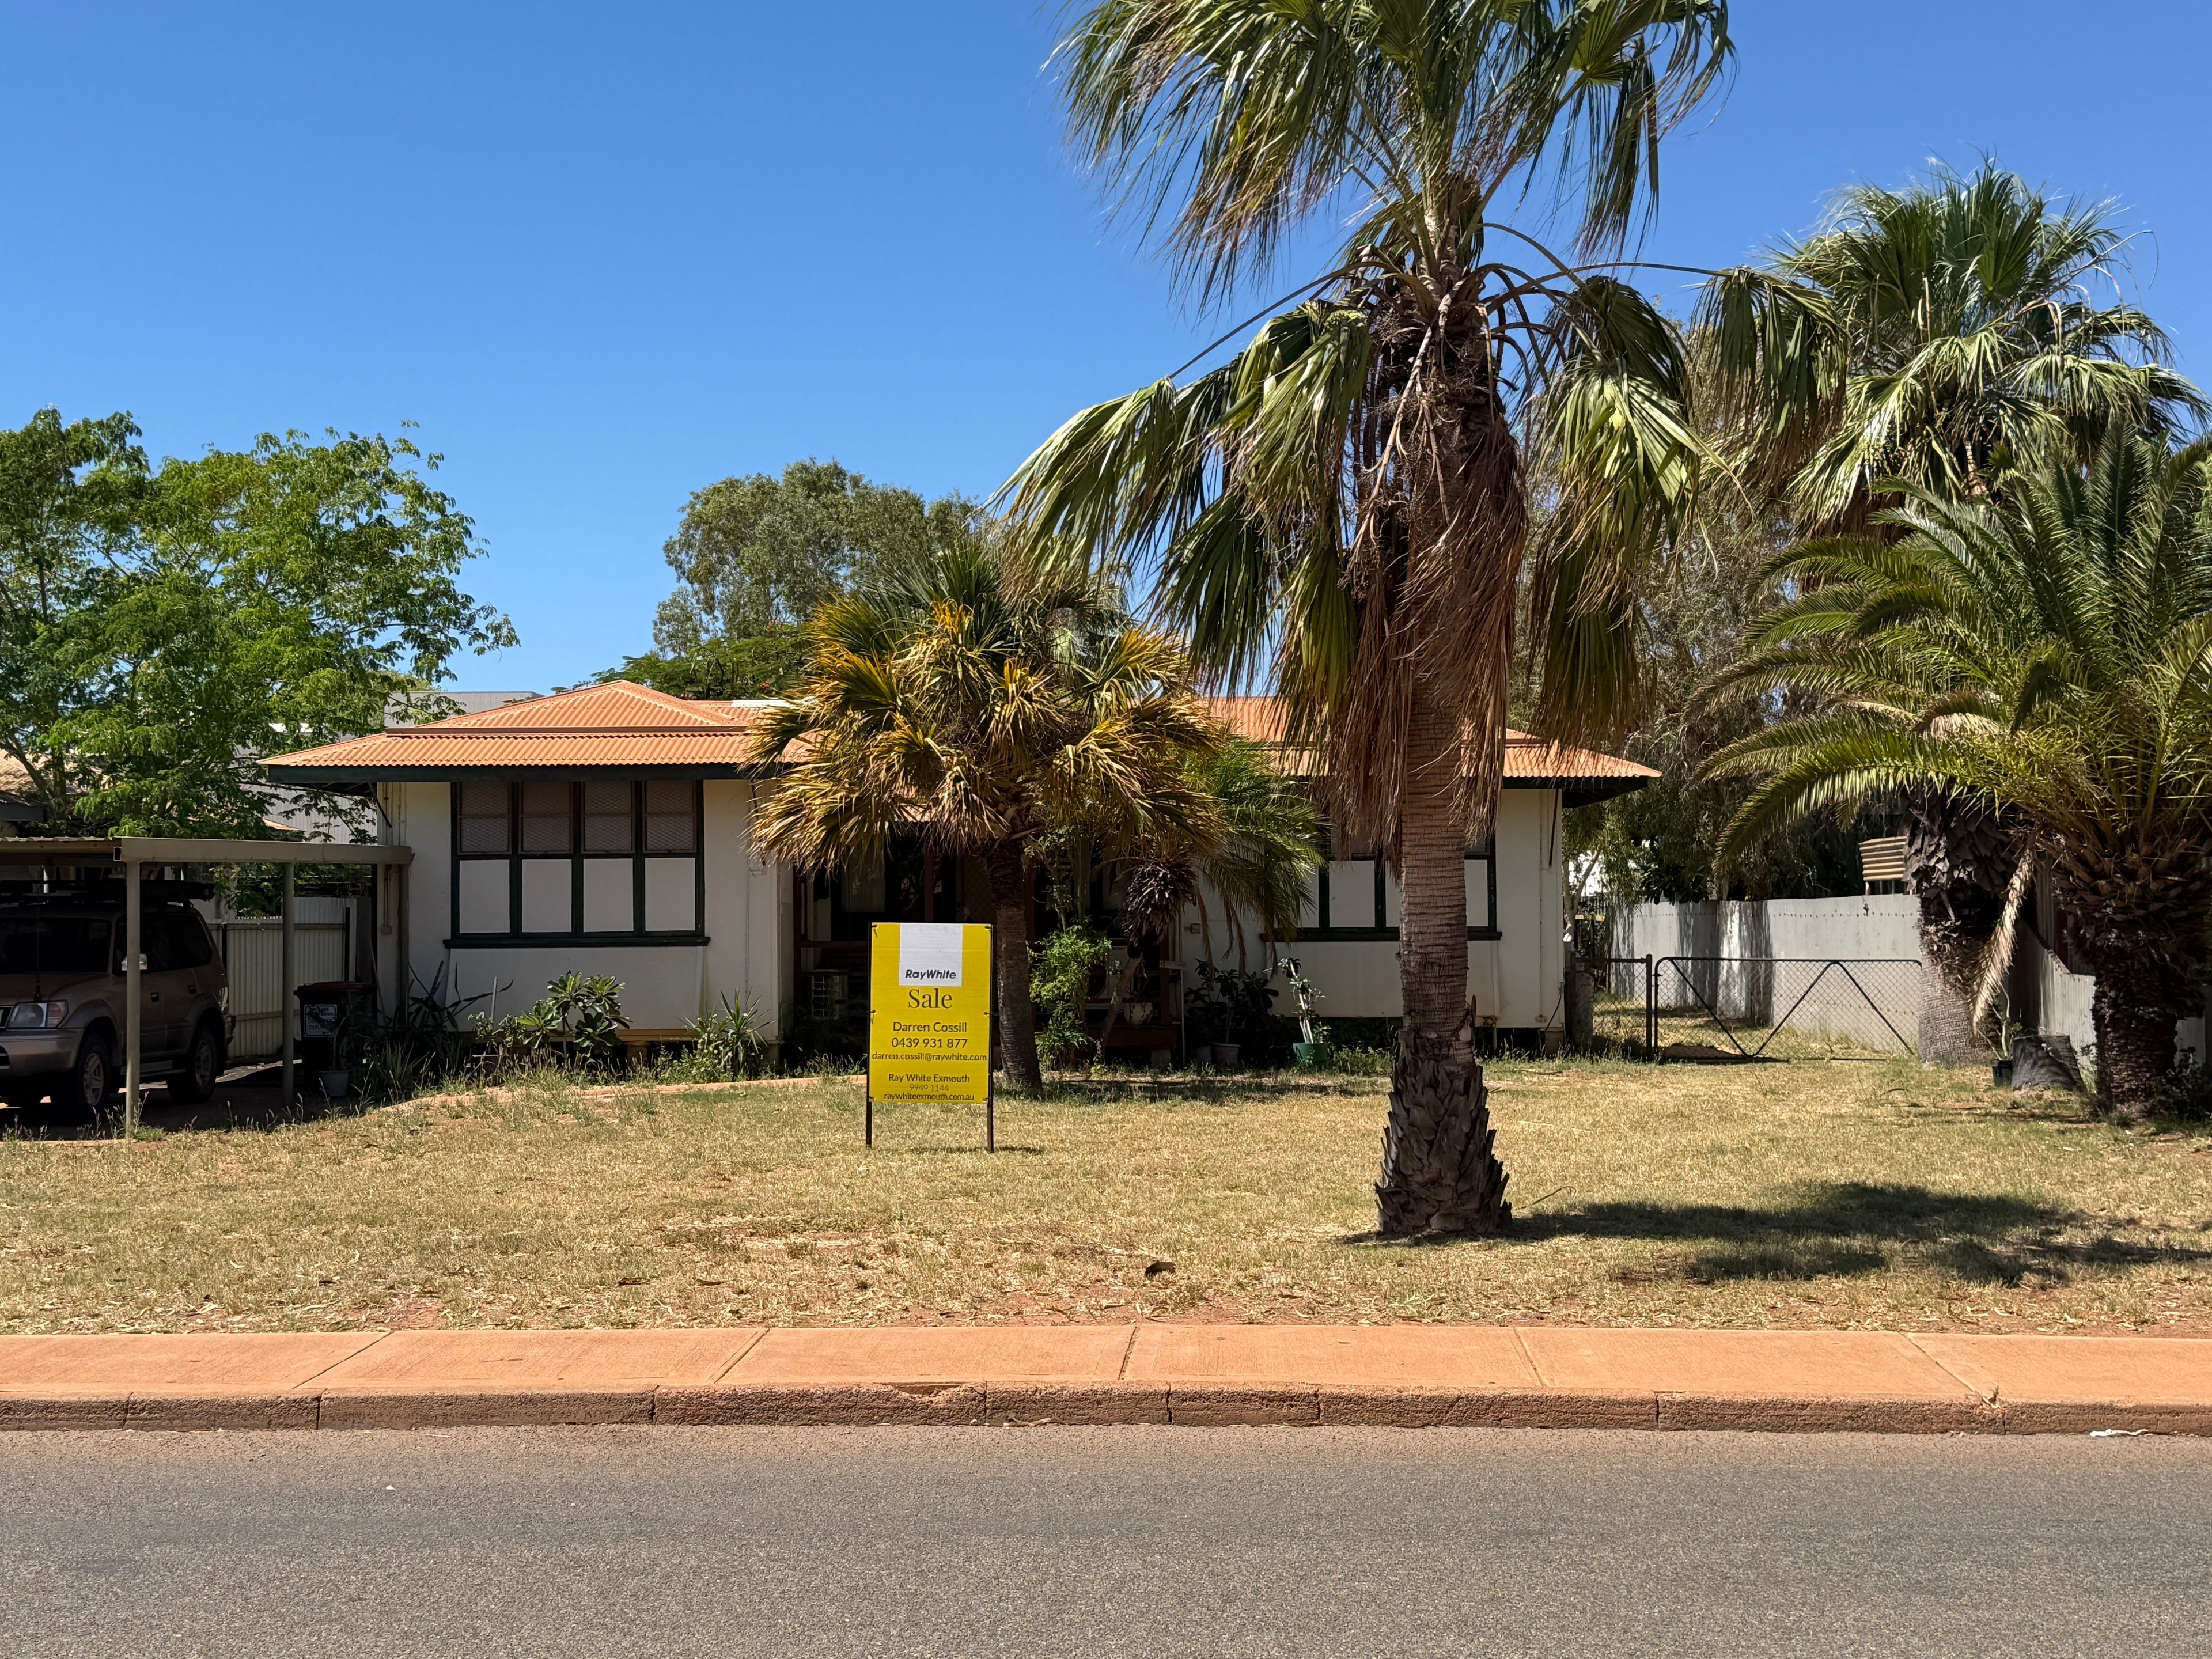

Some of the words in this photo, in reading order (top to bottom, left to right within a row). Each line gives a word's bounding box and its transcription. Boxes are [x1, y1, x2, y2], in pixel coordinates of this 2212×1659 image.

[908, 988, 953, 1009] Sale
[893, 1021, 930, 1032] Darren
[933, 1022, 967, 1032] Cossill
[892, 1037, 919, 1048] 0439
[923, 1038, 943, 1048] 931
[946, 1039, 968, 1048] 877
[872, 1052, 987, 1061] darren.cossill@raywhite.com
[888, 1074, 904, 1083] Ray
[906, 1074, 931, 1082] White
[933, 1074, 970, 1083] Exmouth
[884, 1092, 975, 1101] raywhiteexmouth.com.au
